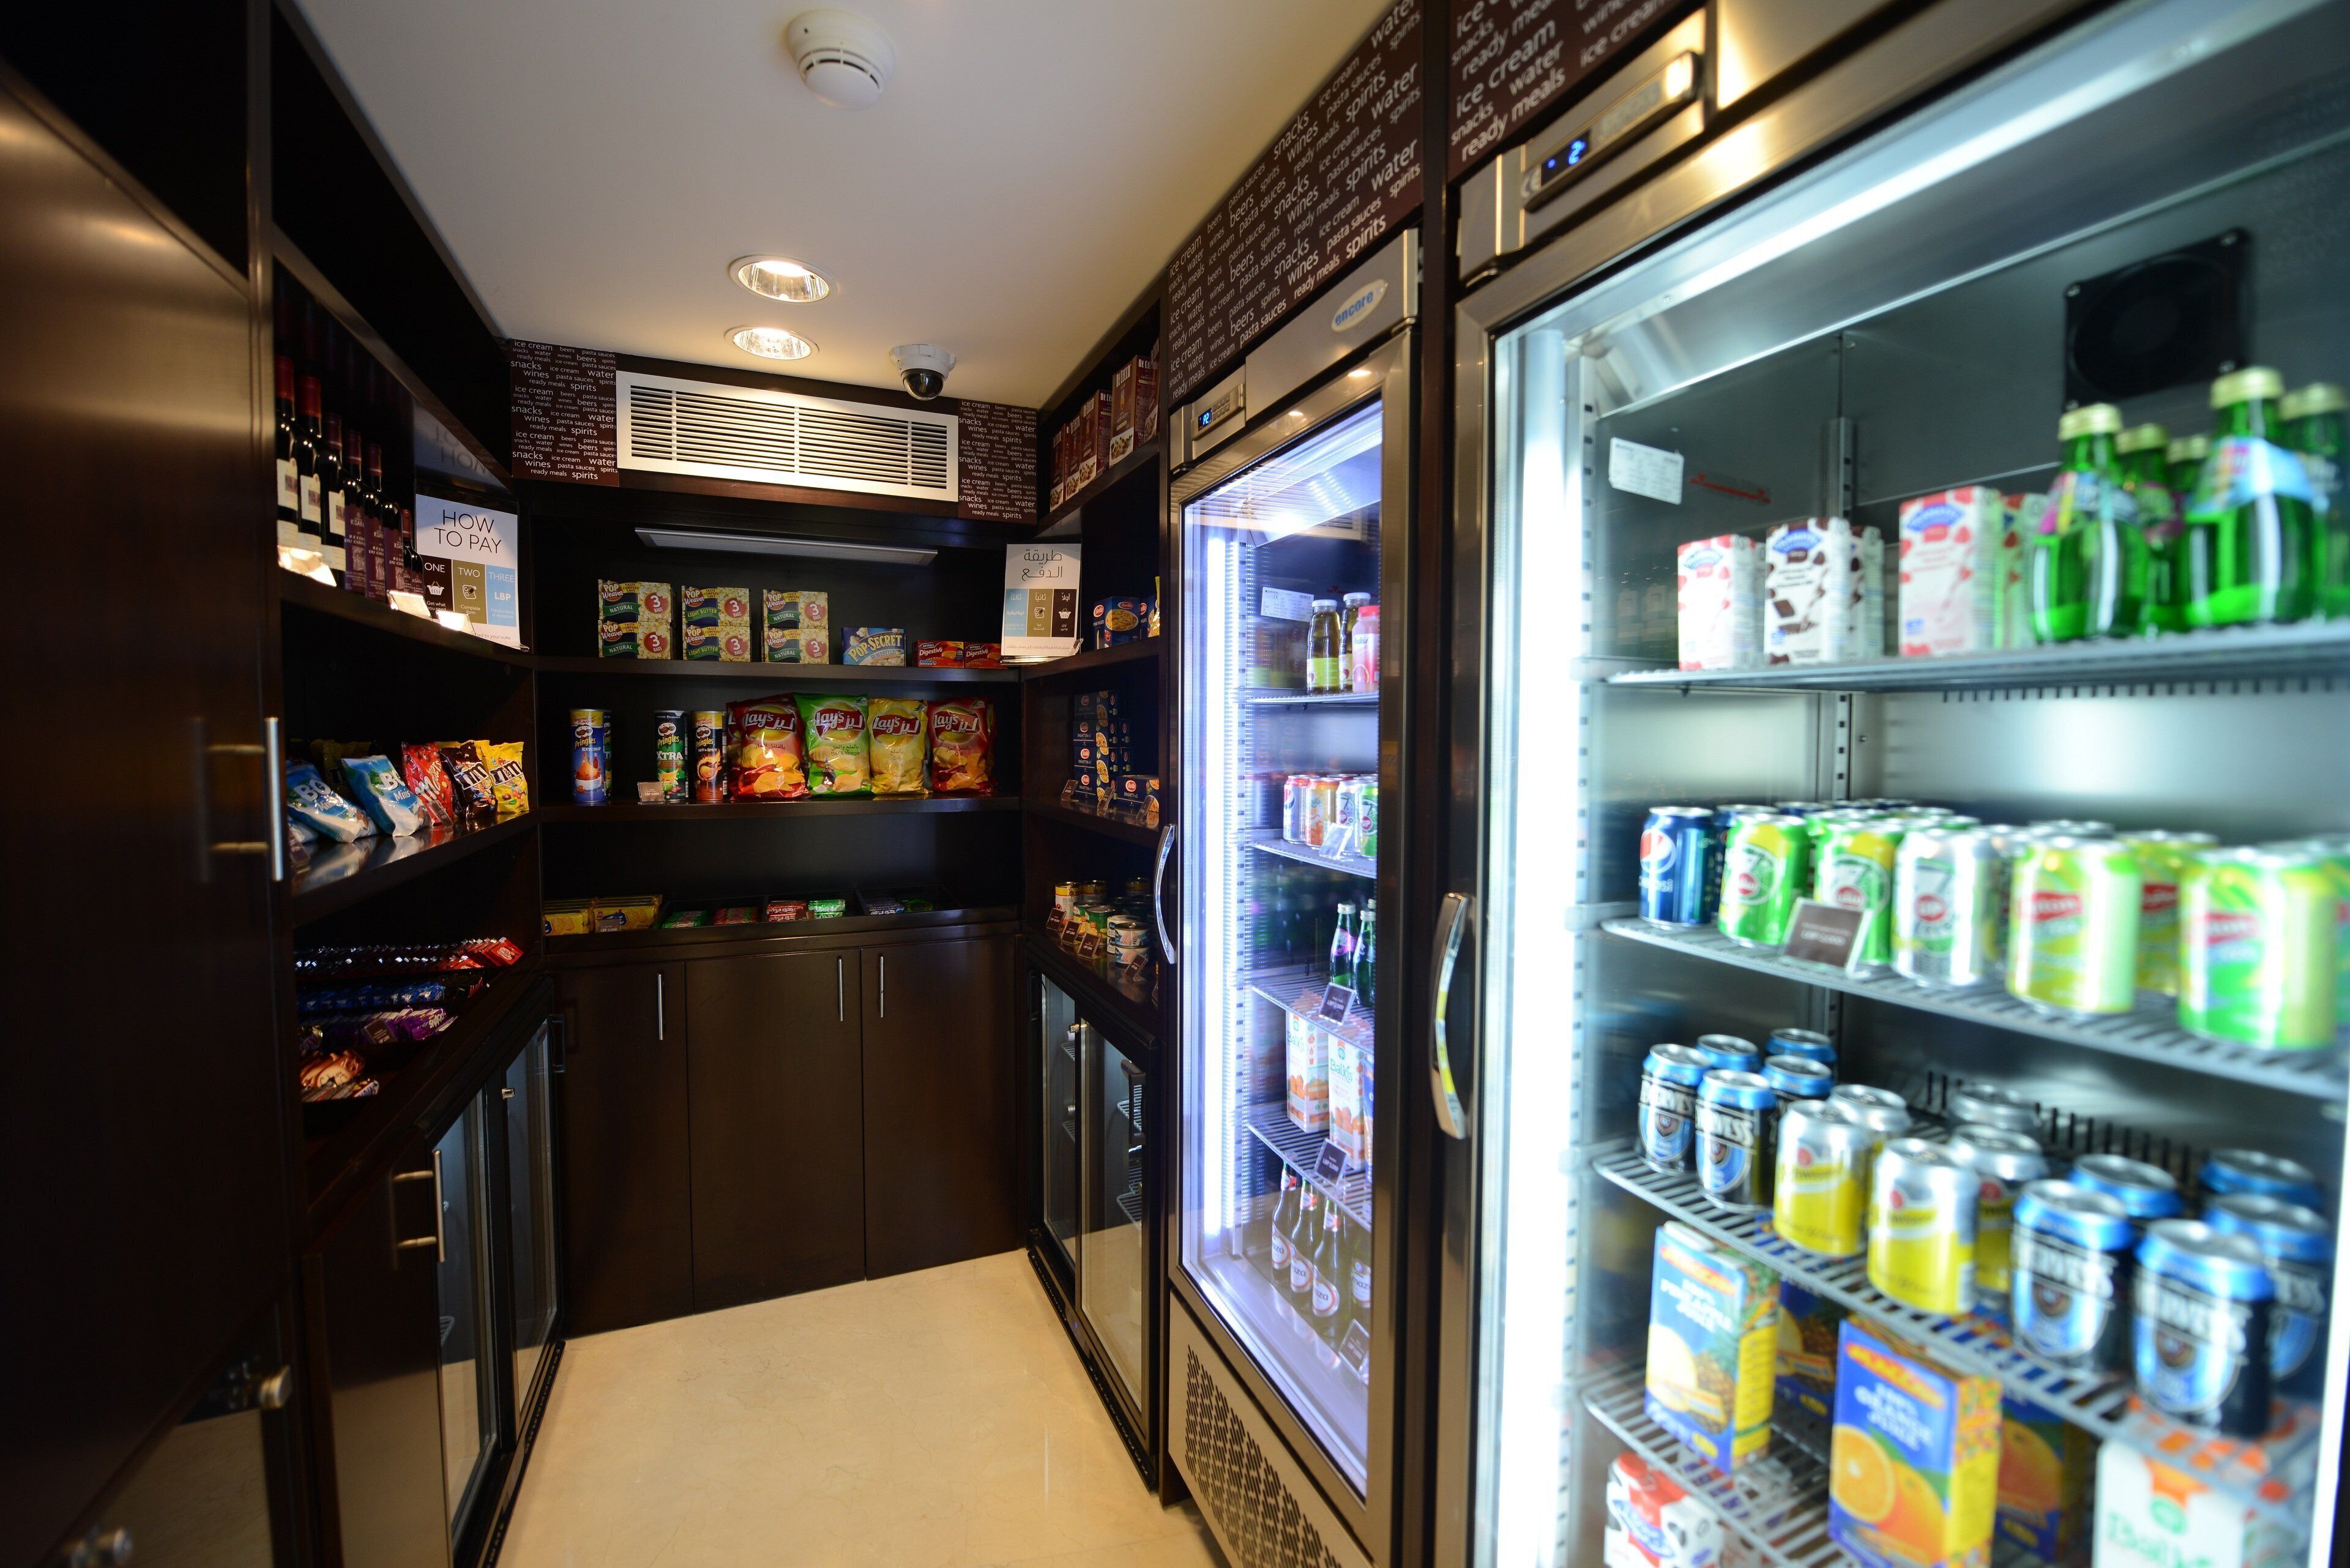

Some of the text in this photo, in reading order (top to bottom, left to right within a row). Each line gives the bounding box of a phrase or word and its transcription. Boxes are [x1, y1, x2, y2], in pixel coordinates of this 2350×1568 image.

[1457, 20, 1556, 118] ice cream
[1452, 41, 1563, 146] snacks water
[1462, 37, 1607, 162] ready meals ice
[1171, 139, 1417, 373] ice cream beers pasta sauces snacks ice cream water
[1169, 163, 1420, 388] snacks water wines beers spirits wines pasta sauces spirits
[1173, 380, 1188, 400] ready
[1188, 366, 1205, 387] meals
[1218, 342, 1235, 362] cream
[1240, 323, 1259, 348] pasta
[1261, 299, 1286, 328] sauces
[1294, 275, 1315, 299] ready
[1316, 253, 1340, 282] meals
[1346, 215, 1386, 259] spirits
[1336, 291, 1373, 326] encore
[511, 361, 542, 370] snacks
[523, 370, 549, 378] wines
[570, 383, 597, 392] spirits
[442, 509, 494, 533] HOW
[434, 528, 502, 553] TO PAY
[1024, 549, 1062, 565] طريقة
[424, 562, 446, 573] ONE
[458, 567, 480, 578] TWO
[1021, 566, 1063, 581] الدفع
[488, 572, 515, 583] THREE
[494, 592, 511, 601] LBP
[650, 595, 661, 608] 3
[729, 600, 740, 612] 3
[810, 603, 819, 616] 3
[601, 630, 623, 639] Weaver
[603, 624, 619, 632] POP
[649, 635, 660, 647] 3
[685, 635, 706, 643] Weaver
[731, 638, 740, 651] 3
[767, 637, 787, 646] Weaver
[609, 644, 632, 653] NATURAL
[811, 641, 820, 652] 3
[919, 647, 943, 655] Digestive
[966, 649, 988, 657] Digestive
[744, 712, 774, 727] Lay's
[765, 717, 795, 730] ليز
[816, 711, 845, 728] Lay's
[837, 715, 863, 731] ليز
[873, 717, 900, 734] Lay's
[934, 714, 958, 730] Lay's
[952, 718, 979, 733] ليز
[892, 720, 920, 736] ليز
[575, 736, 596, 750] Pringles
[657, 734, 679, 748] Pringles
[696, 737, 714, 748] Pringles
[657, 751, 684, 761] XTRA
[1330, 1059, 1352, 1083] Balkis
